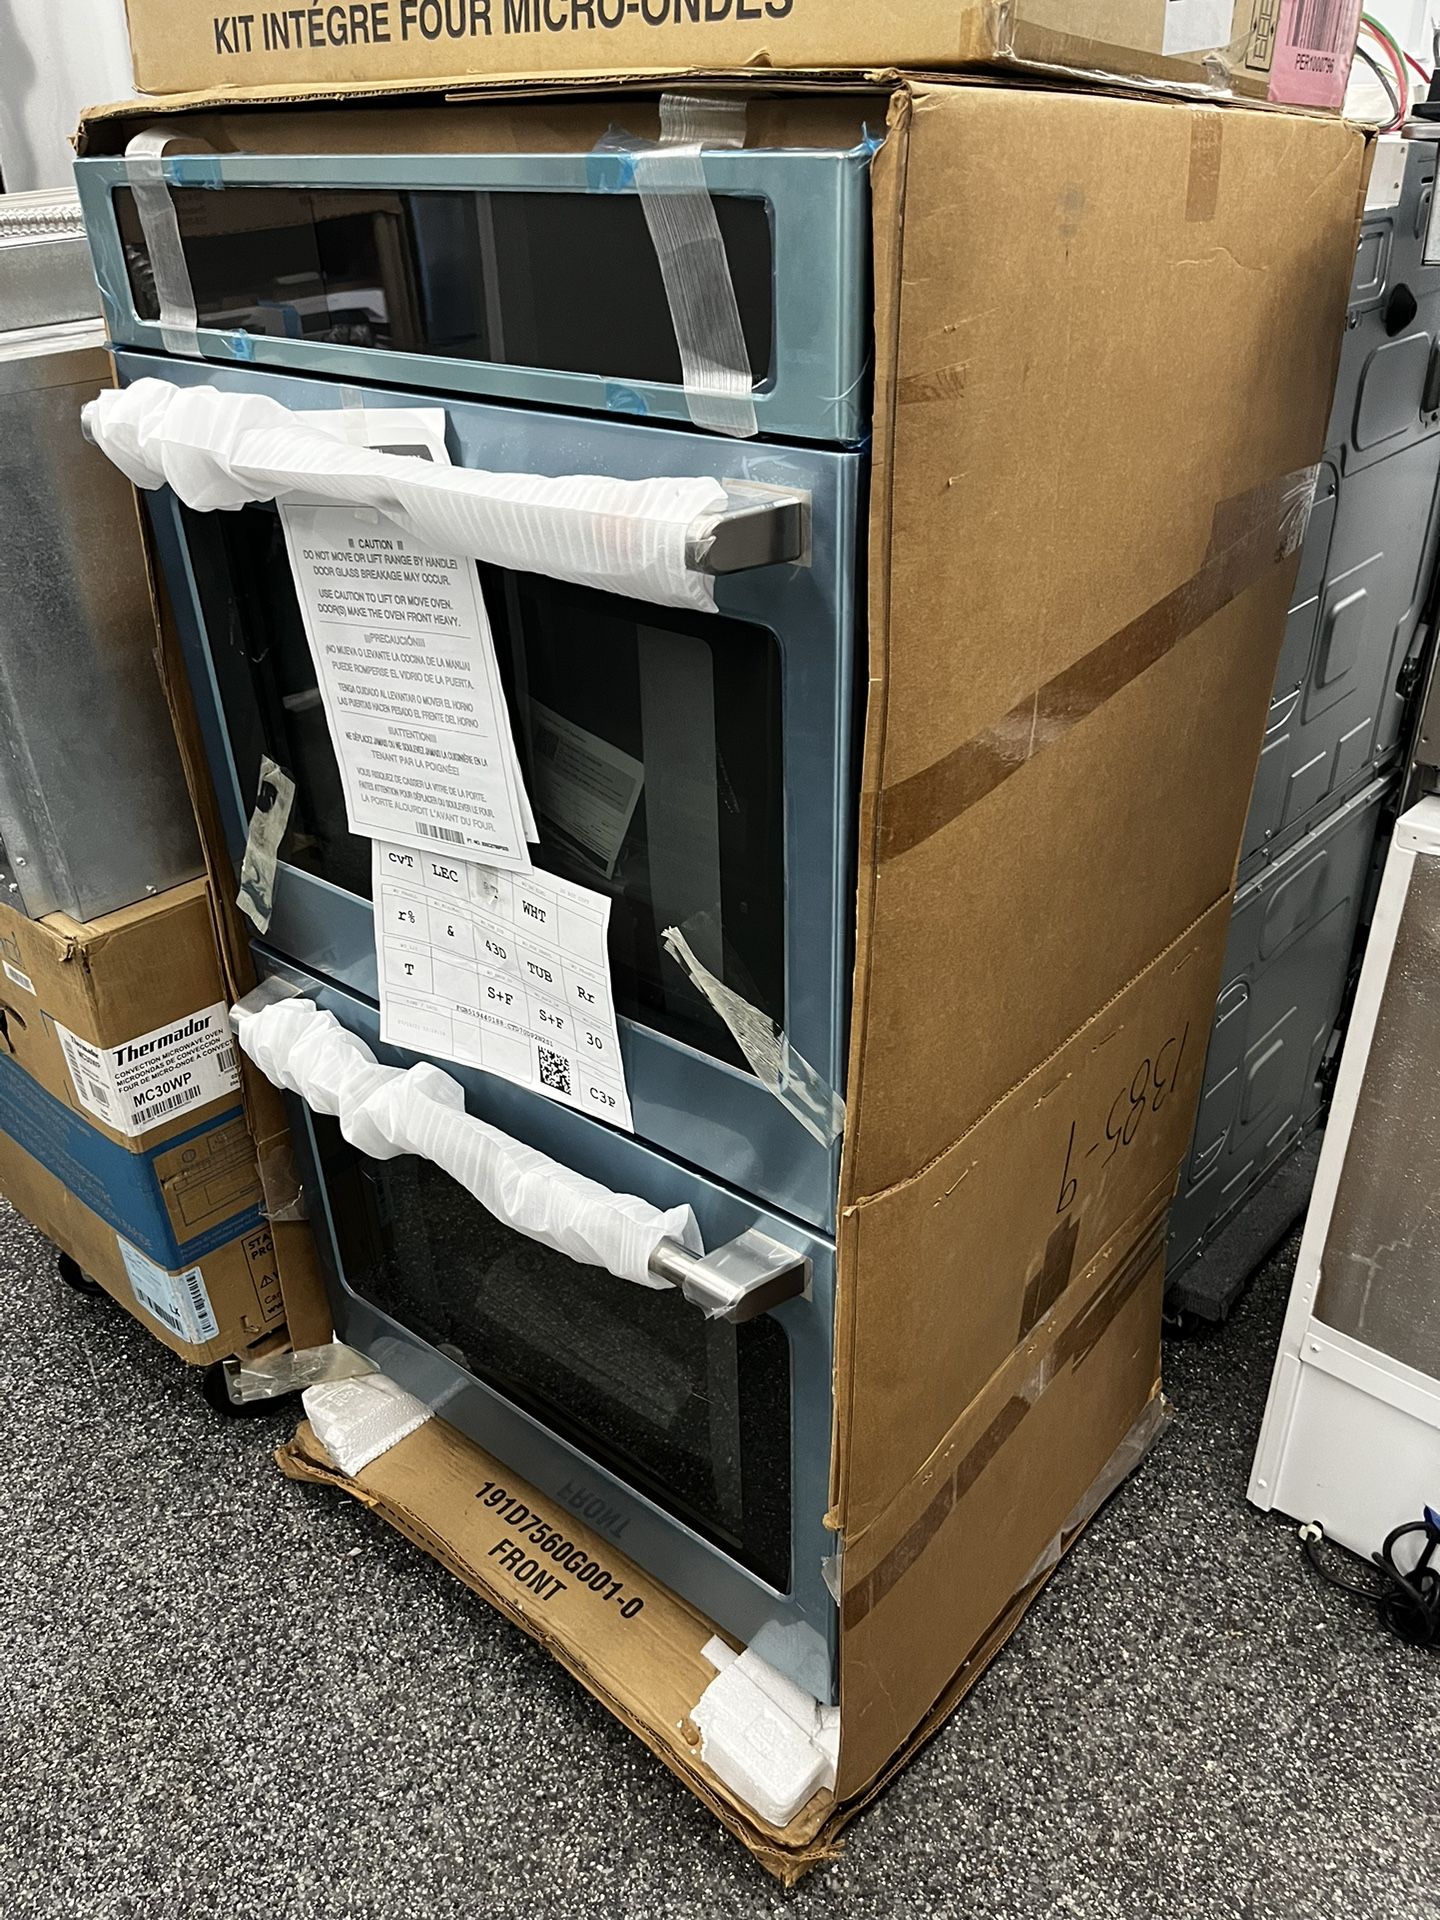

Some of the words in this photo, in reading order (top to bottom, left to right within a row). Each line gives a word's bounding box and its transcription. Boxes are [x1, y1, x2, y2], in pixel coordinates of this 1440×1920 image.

[214, 15, 254, 54] KIT
[262, 0, 391, 51] INTÉGRE
[401, 0, 492, 41] FOUR
[358, 539, 393, 550] CAUTION
[303, 550, 314, 560] DO
[315, 551, 329, 560] NOT
[332, 552, 353, 562] MOVE
[354, 553, 366, 562] OR
[367, 554, 382, 564] LIFT
[385, 555, 412, 565] RANGE
[414, 556, 423, 566] BY
[313, 566, 335, 576] DOOR
[336, 567, 360, 578] GLASS
[361, 569, 402, 581] BREAKAGE
[404, 572, 419, 582] MAY
[422, 573, 451, 585] OCCUR.
[319, 589, 333, 598] USE
[334, 590, 365, 602] CAUTION
[366, 593, 375, 603] TO
[377, 594, 393, 604] LIFT
[395, 595, 407, 605] OR
[407, 596, 430, 607] MOVE
[318, 603, 347, 617] DOOR(S)
[349, 607, 367, 617] MAKE
[368, 608, 382, 619] THE
[384, 609, 405, 620] OVEN
[407, 612, 432, 623] FRONT
[434, 614, 461, 627] HEAVY.
[358, 648, 363, 657] O
[364, 649, 391, 660] LEVANTE
[392, 652, 400, 661] LA
[401, 653, 425, 665] COCINA
[426, 656, 435, 666] DE
[435, 657, 445, 667] LA
[332, 661, 353, 672] PUEDE
[354, 663, 389, 677] ROMPERSE
[390, 669, 399, 679] EL
[400, 670, 423, 682] VIDRIO
[425, 674, 434, 683] DE
[435, 675, 444, 685] LA
[453, 700, 473, 712] HORNO
[457, 715, 479, 728] HORNO
[371, 750, 397, 763] TENANT
[400, 755, 414, 766] PAR
[415, 758, 424, 768] LA
[361, 794, 370, 802] LA
[371, 795, 393, 808] PORTE
[395, 801, 429, 815] ALOURDIT
[430, 807, 458, 823] L'AVANT
[461, 814, 471, 826] DU
[432, 864, 458, 882] LEC
[522, 900, 546, 923] WHT
[398, 910, 415, 923] r%
[447, 925, 455, 937] &
[485, 940, 506, 959] 43D
[405, 963, 414, 975] T
[527, 961, 552, 982] TUB
[577, 986, 595, 1004] Rr
[112, 1015, 212, 1066] Thermador
[586, 1032, 602, 1049] 30
[115, 1056, 160, 1080] CONVECTION
[162, 1039, 203, 1060] MICROWAVE
[205, 1028, 224, 1041] OVEN
[117, 1062, 165, 1086] MICROONDAS
[166, 1058, 175, 1066] DE
[118, 1080, 139, 1093] FOUR
[140, 1076, 150, 1085] DE
[152, 1058, 194, 1079] MICRO-ONDE
[133, 1071, 192, 1108] MC30WP
[589, 1087, 616, 1108] C3P
[1056, 1021, 1189, 1214] 1385-9
[475, 1481, 644, 1619] 191D7560G001-0
[487, 1538, 568, 1601] FRONT
